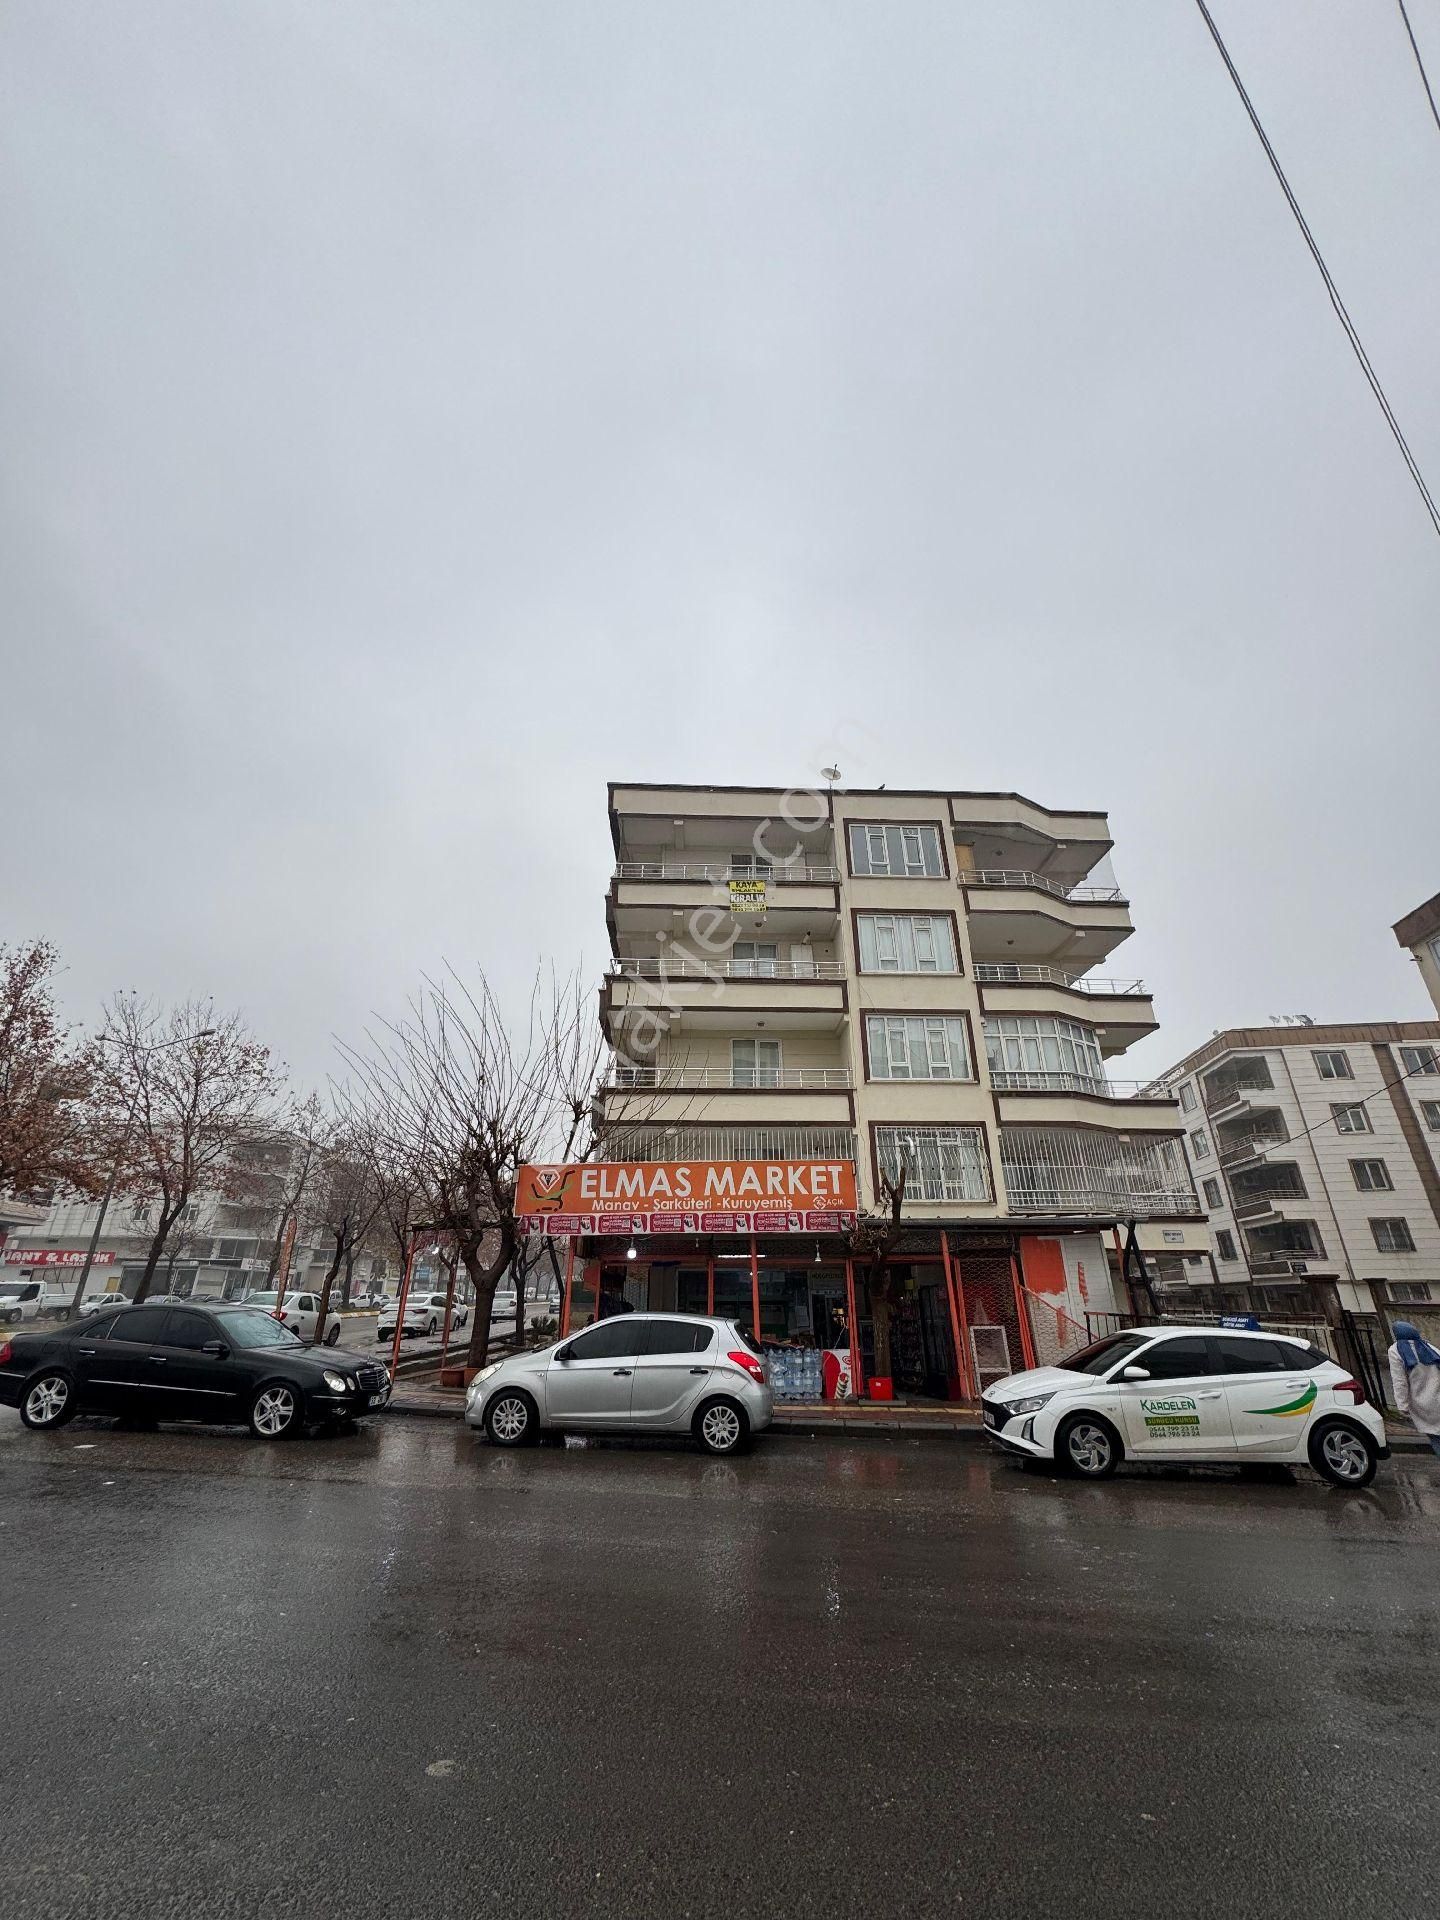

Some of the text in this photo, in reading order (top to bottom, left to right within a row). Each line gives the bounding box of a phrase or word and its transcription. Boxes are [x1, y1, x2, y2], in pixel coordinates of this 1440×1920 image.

[730, 893, 765, 902] KİRALIK
[580, 1165, 843, 1199] ELMAS MARKET
[592, 1199, 639, 1211] Manav
[653, 1198, 712, 1211] Şarküteri
[827, 1198, 844, 1206] AÇIK
[62, 1251, 110, 1262] LASİK
[1140, 1399, 1196, 1411] KARDELEN
